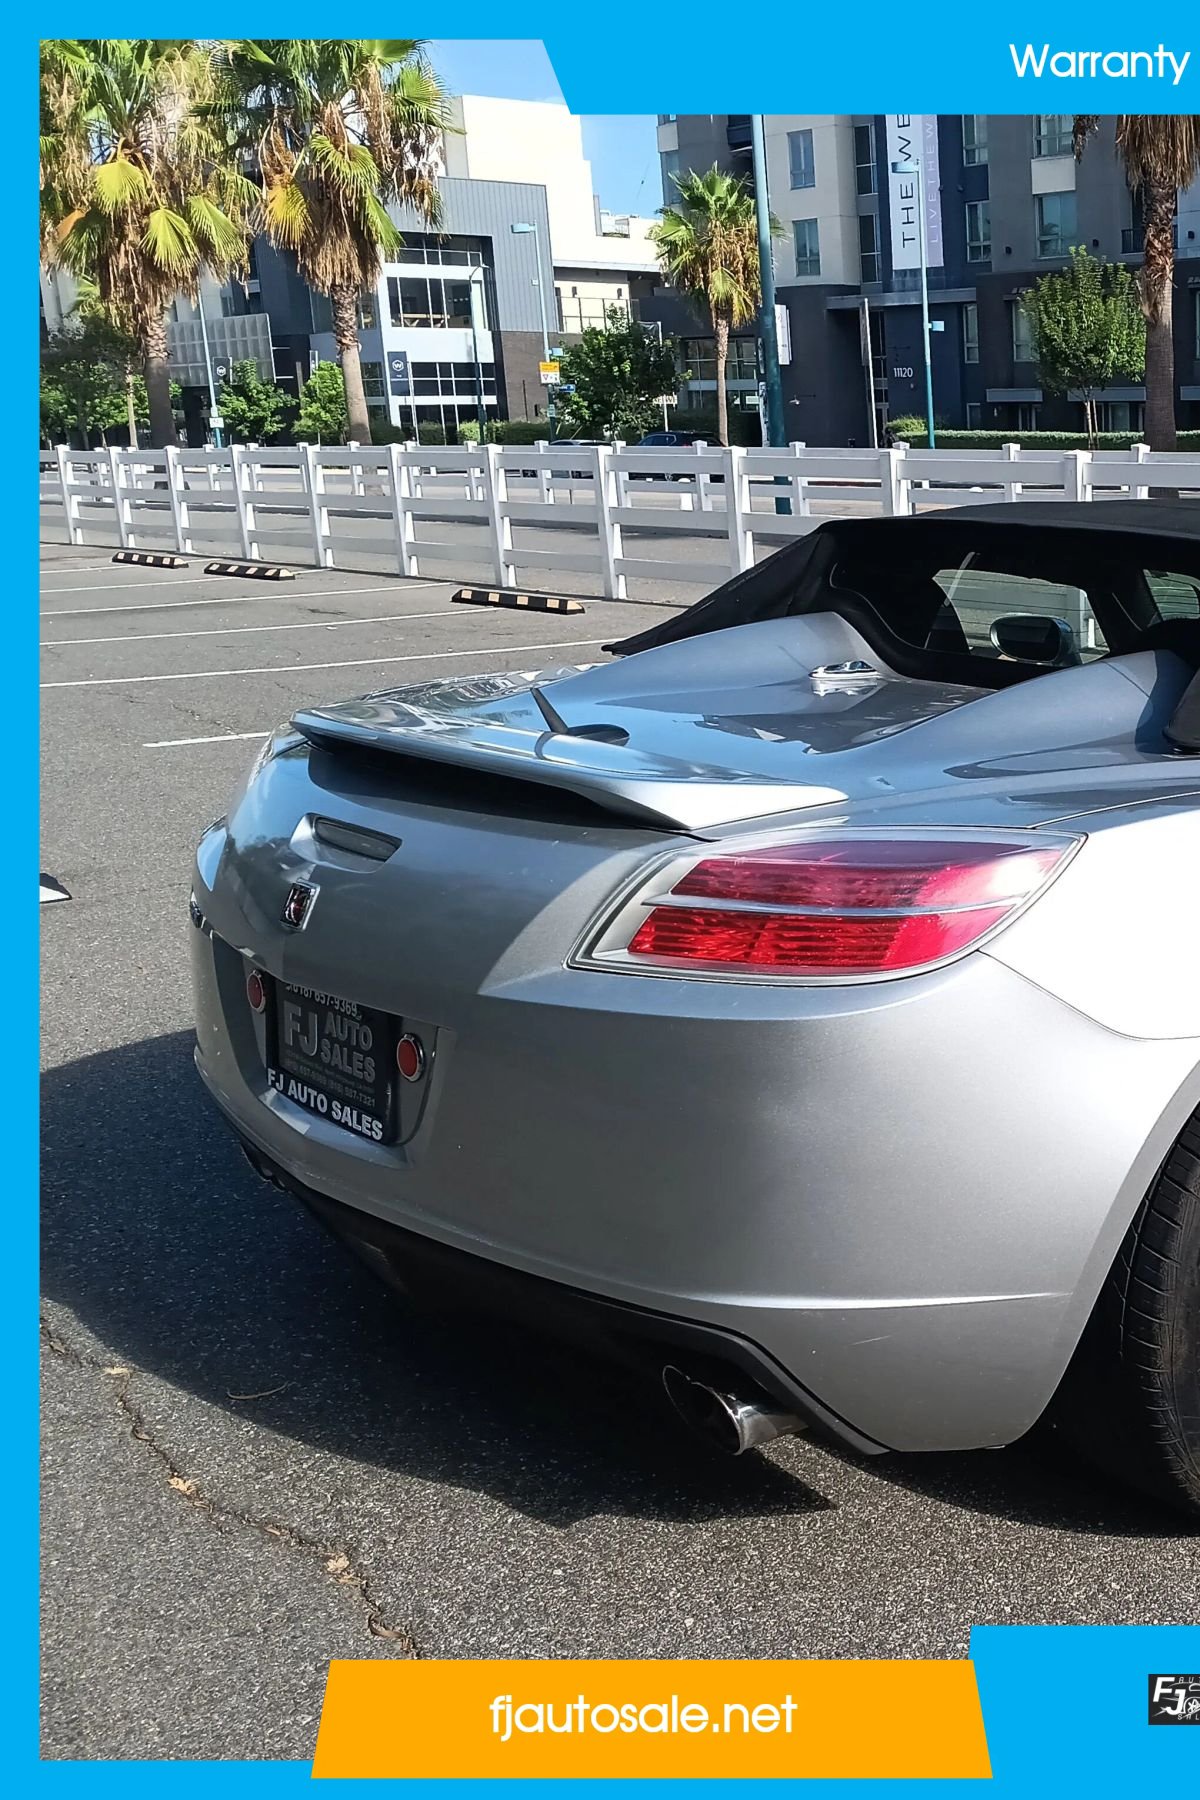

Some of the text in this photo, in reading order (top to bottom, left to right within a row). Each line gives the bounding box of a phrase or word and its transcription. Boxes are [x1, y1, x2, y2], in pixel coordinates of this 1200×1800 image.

[900, 182, 916, 249] THE
[893, 367, 914, 378] 11120
[283, 1000, 373, 1057] FJ AUTO
[320, 1038, 376, 1084] SALES
[287, 1079, 328, 1114] AUTO
[331, 1100, 383, 1141] SALES
